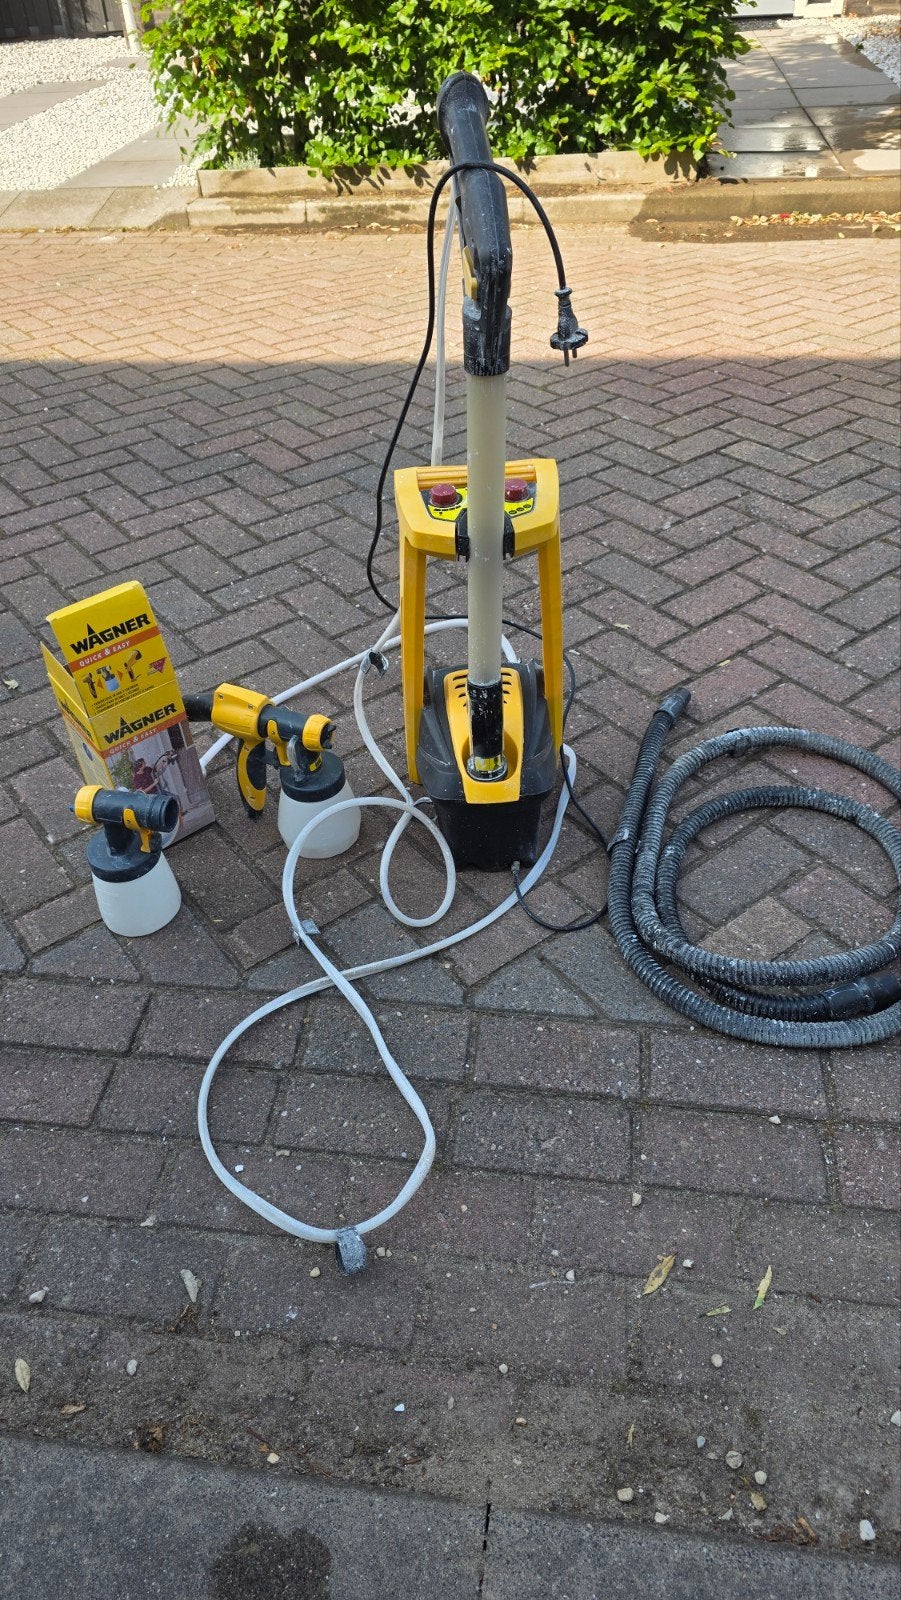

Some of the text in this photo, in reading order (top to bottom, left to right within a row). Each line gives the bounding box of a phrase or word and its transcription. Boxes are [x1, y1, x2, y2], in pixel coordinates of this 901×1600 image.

[70, 613, 151, 655] WAGNER
[79, 641, 130, 667] QUICK & EASY
[104, 702, 177, 743] WAGNER
[109, 741, 132, 753] QUICK
[141, 728, 157, 739] EASY
